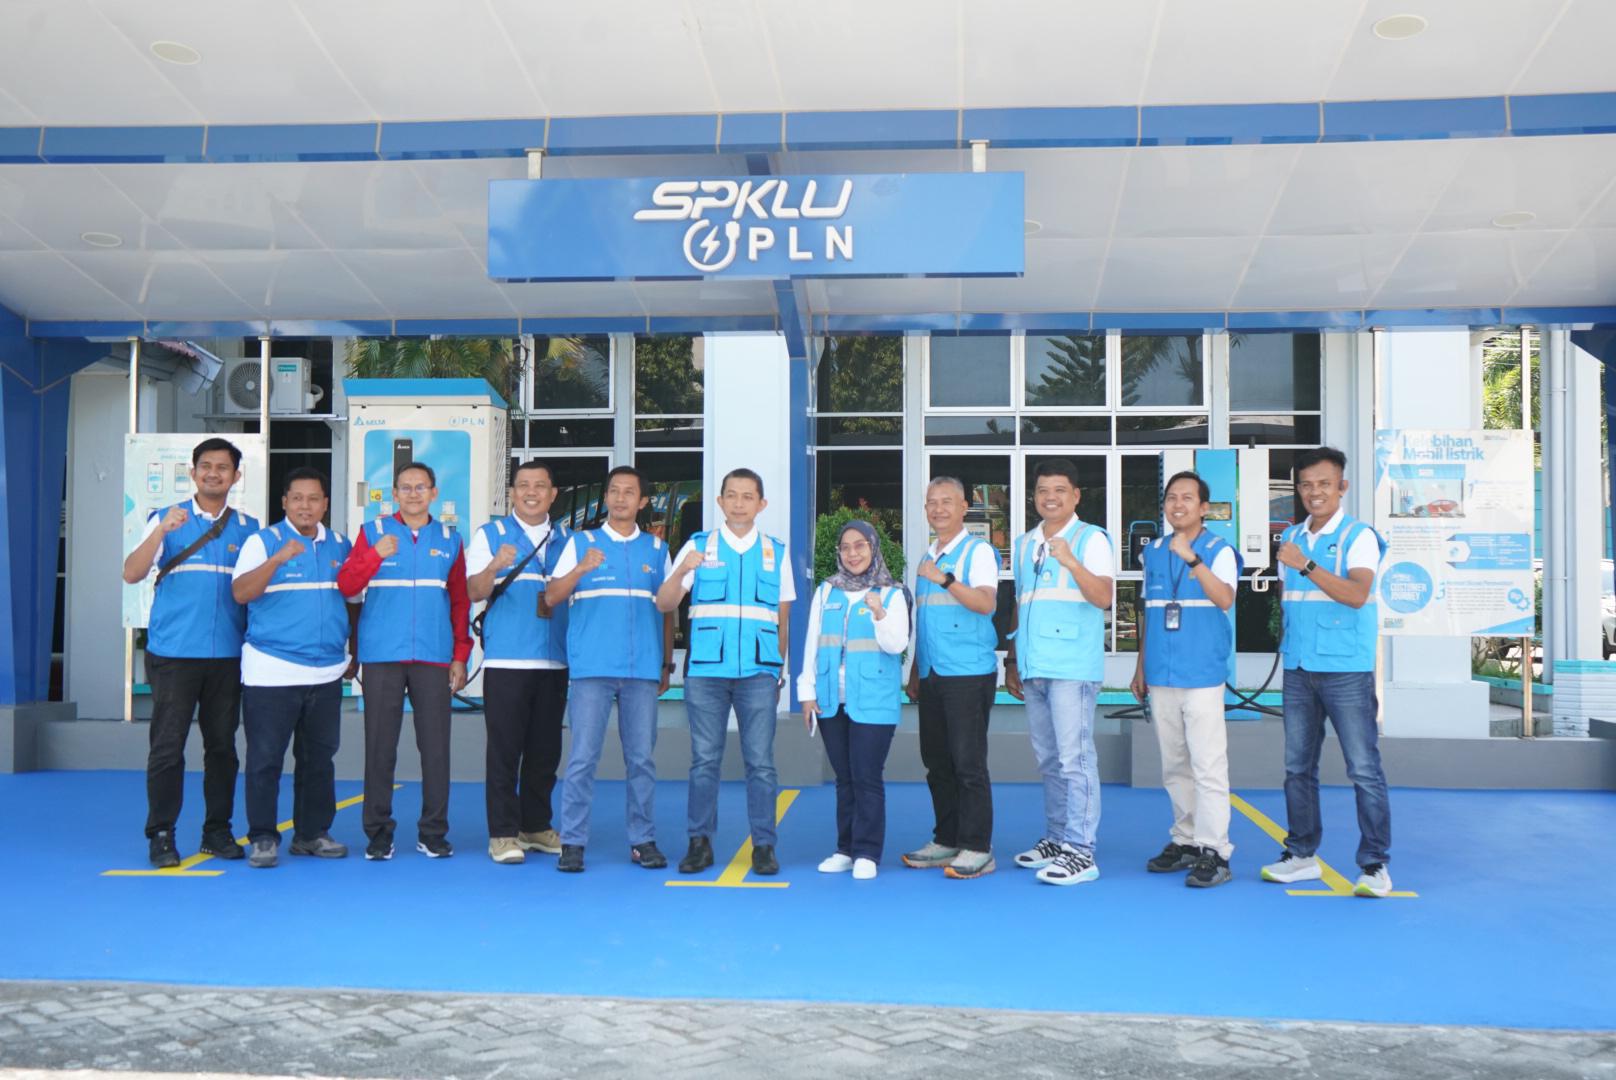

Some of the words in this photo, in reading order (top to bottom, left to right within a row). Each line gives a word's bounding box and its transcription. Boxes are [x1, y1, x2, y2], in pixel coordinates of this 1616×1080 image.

[633, 179, 853, 221] SPKLU
[748, 226, 853, 262] PLN
[1446, 447, 1484, 460] listrik
